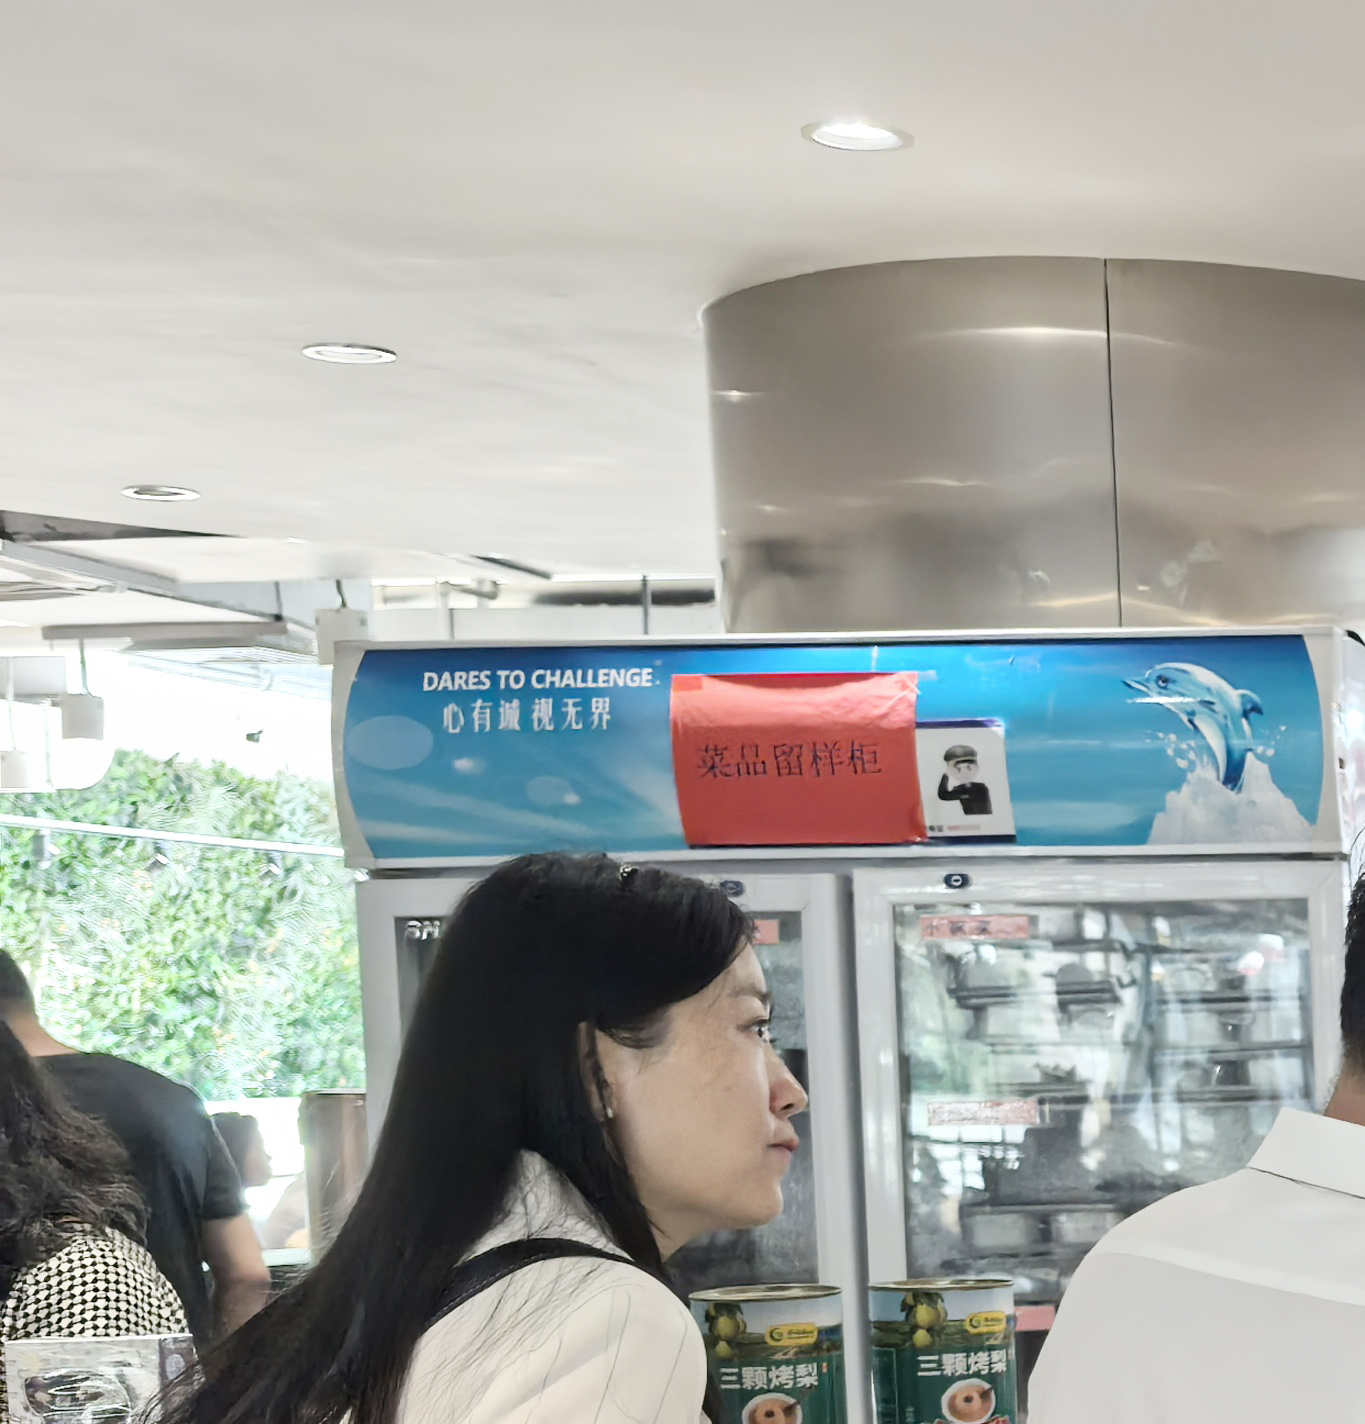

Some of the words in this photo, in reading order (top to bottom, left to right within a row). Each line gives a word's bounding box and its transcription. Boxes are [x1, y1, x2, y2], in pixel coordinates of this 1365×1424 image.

[423, 671, 491, 691] DARES
[497, 669, 526, 690] TO
[531, 668, 653, 689] CHALLENGE
[699, 740, 882, 778] 菜品留样柜
[719, 1362, 819, 1390] 三颗烤梨
[917, 1349, 1007, 1376] 三颗烤梨
